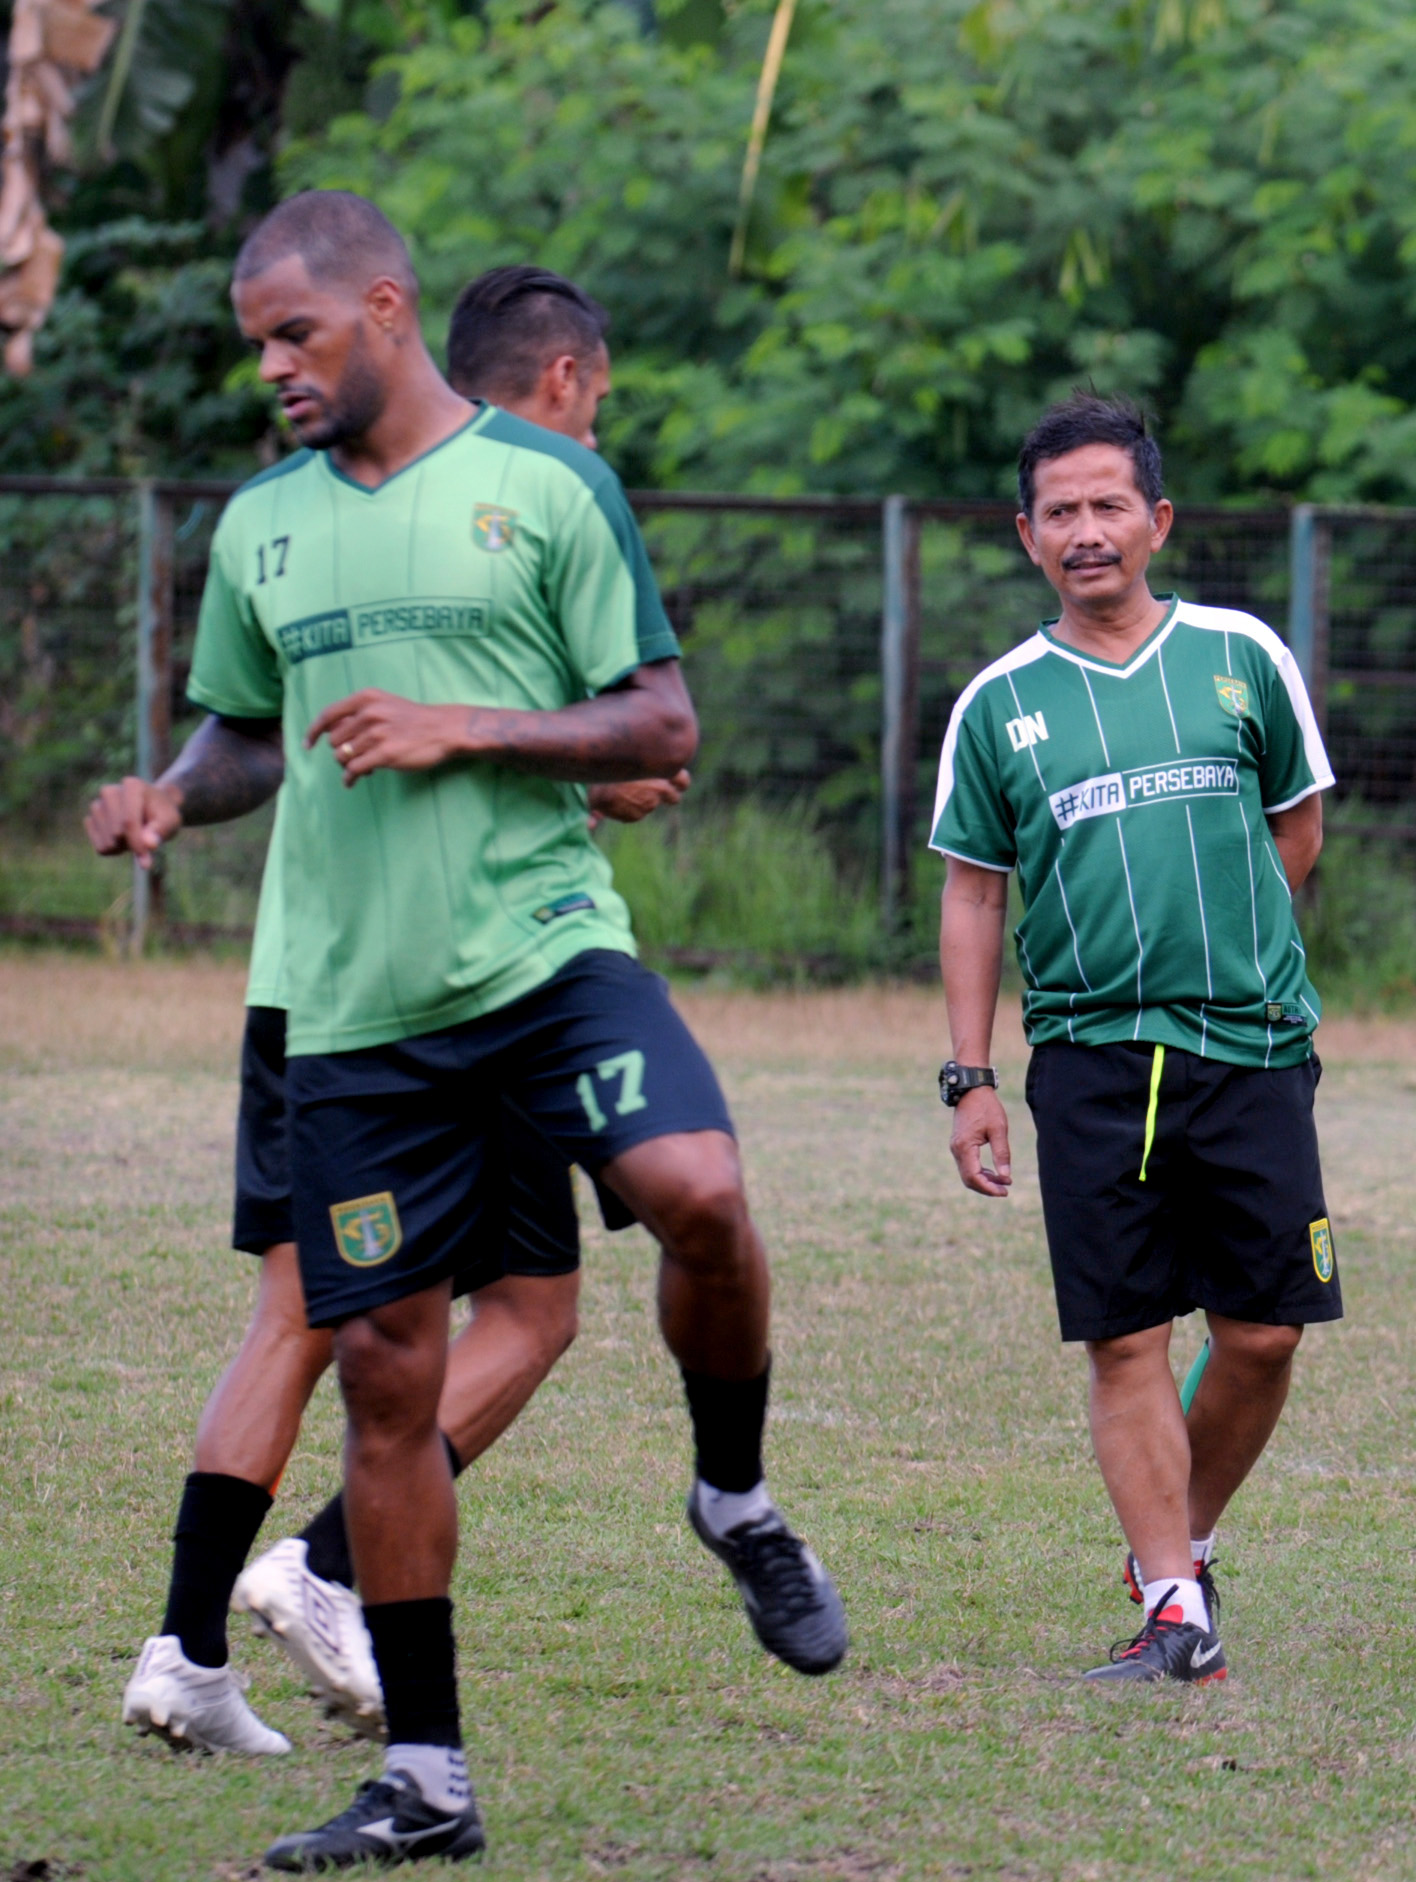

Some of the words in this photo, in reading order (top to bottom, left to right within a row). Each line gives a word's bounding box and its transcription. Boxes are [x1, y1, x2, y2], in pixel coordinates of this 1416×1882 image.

[255, 534, 291, 586] 17
[357, 605, 485, 638] PERSEBAYA
[1005, 710, 1049, 753] DN
[1055, 782, 1120, 822] #KITA
[1129, 765, 1235, 800] PERSEBAYA
[576, 1049, 648, 1133] 17
